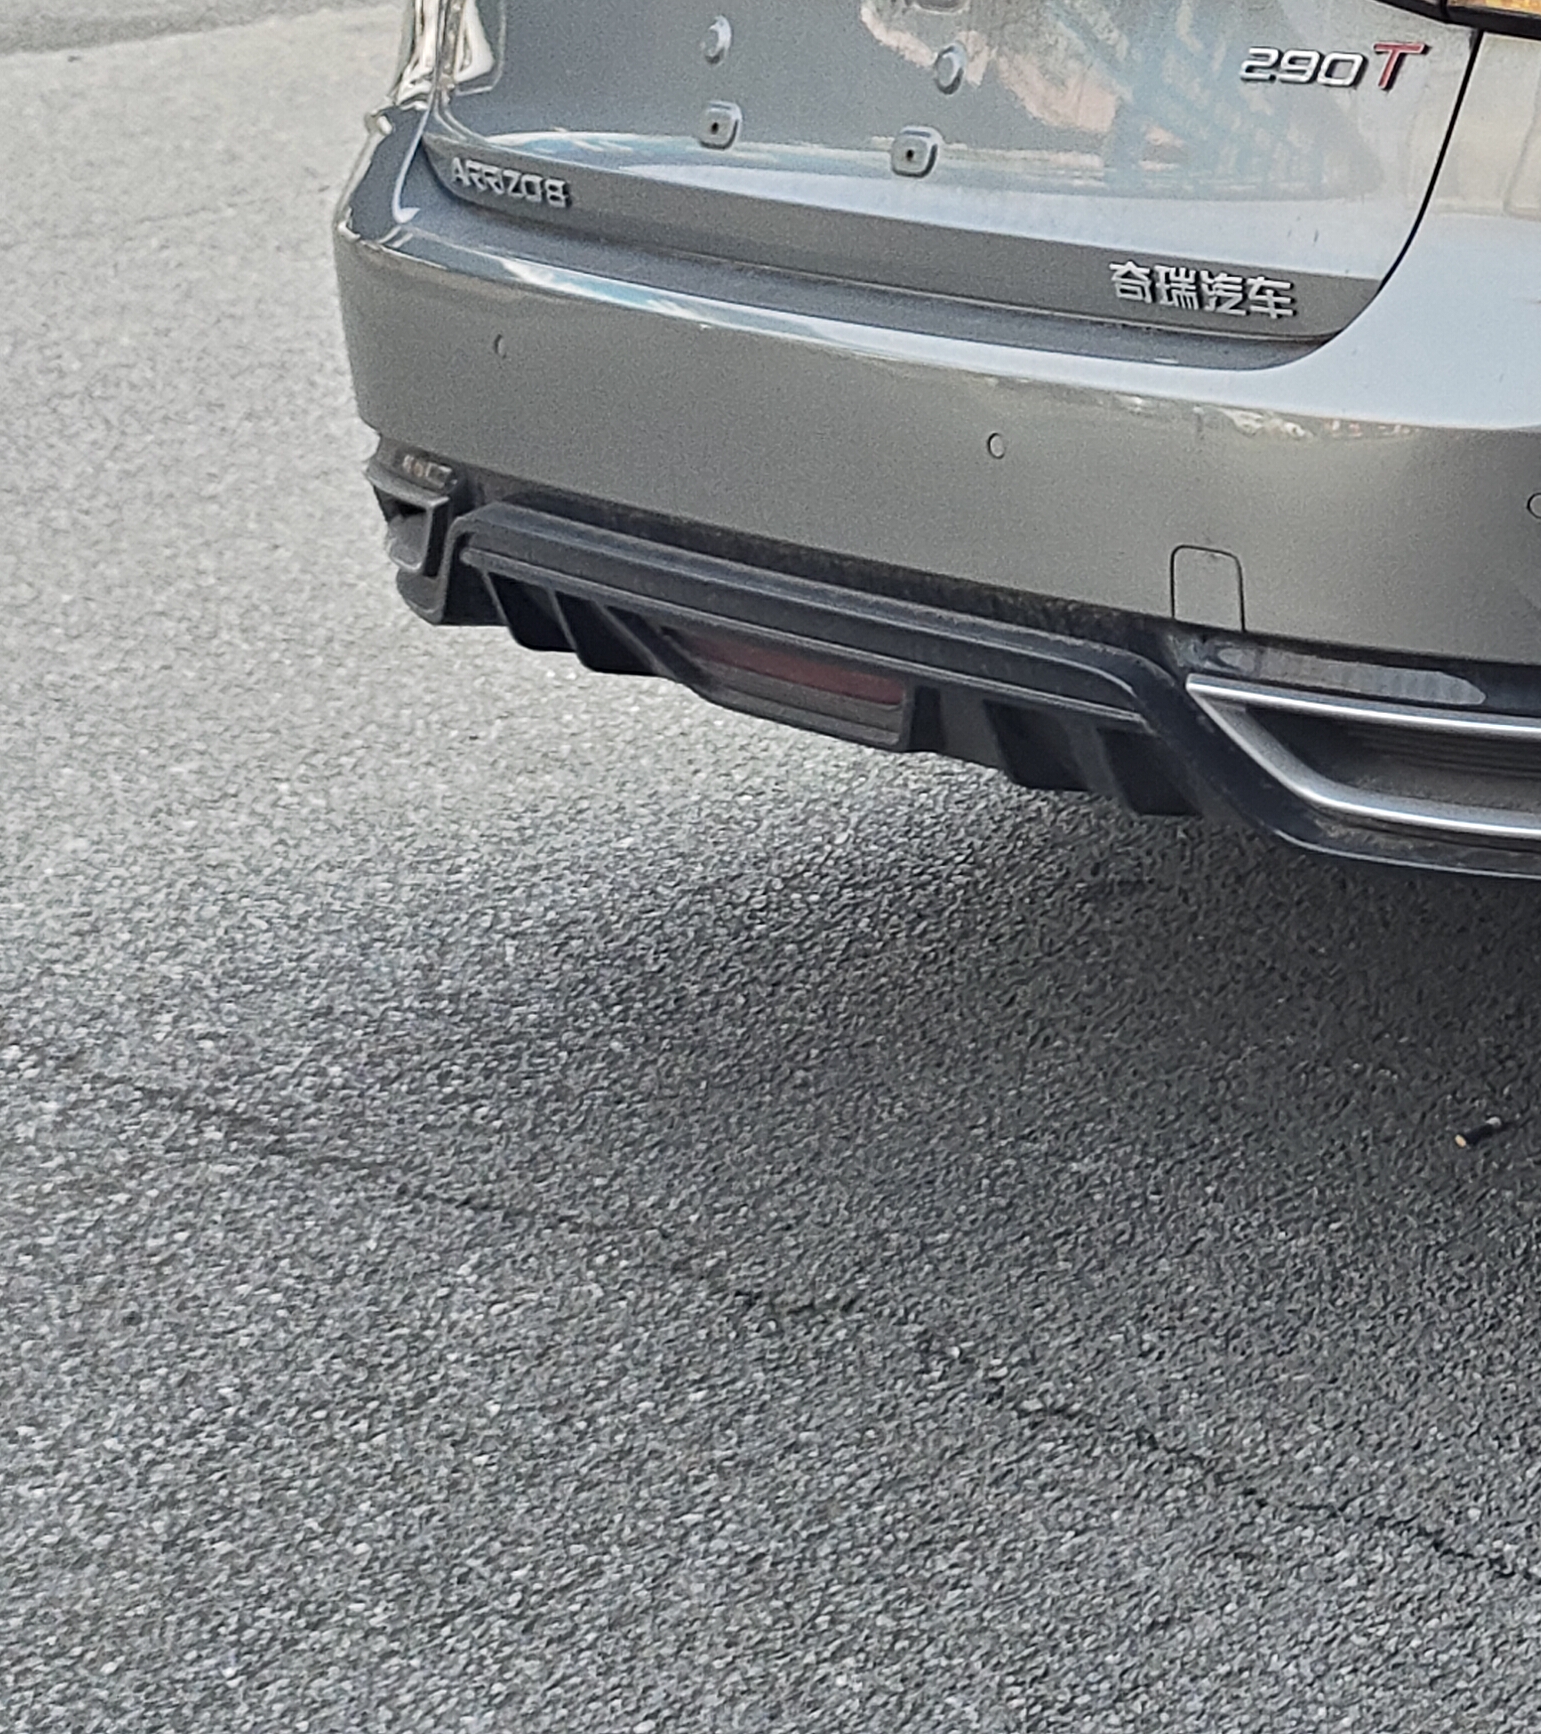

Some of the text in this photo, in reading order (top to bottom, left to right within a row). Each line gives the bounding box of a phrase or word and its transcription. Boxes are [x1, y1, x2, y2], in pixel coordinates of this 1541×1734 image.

[1239, 41, 1429, 89] 290T
[1109, 259, 1297, 321] 奇瑞汽车
